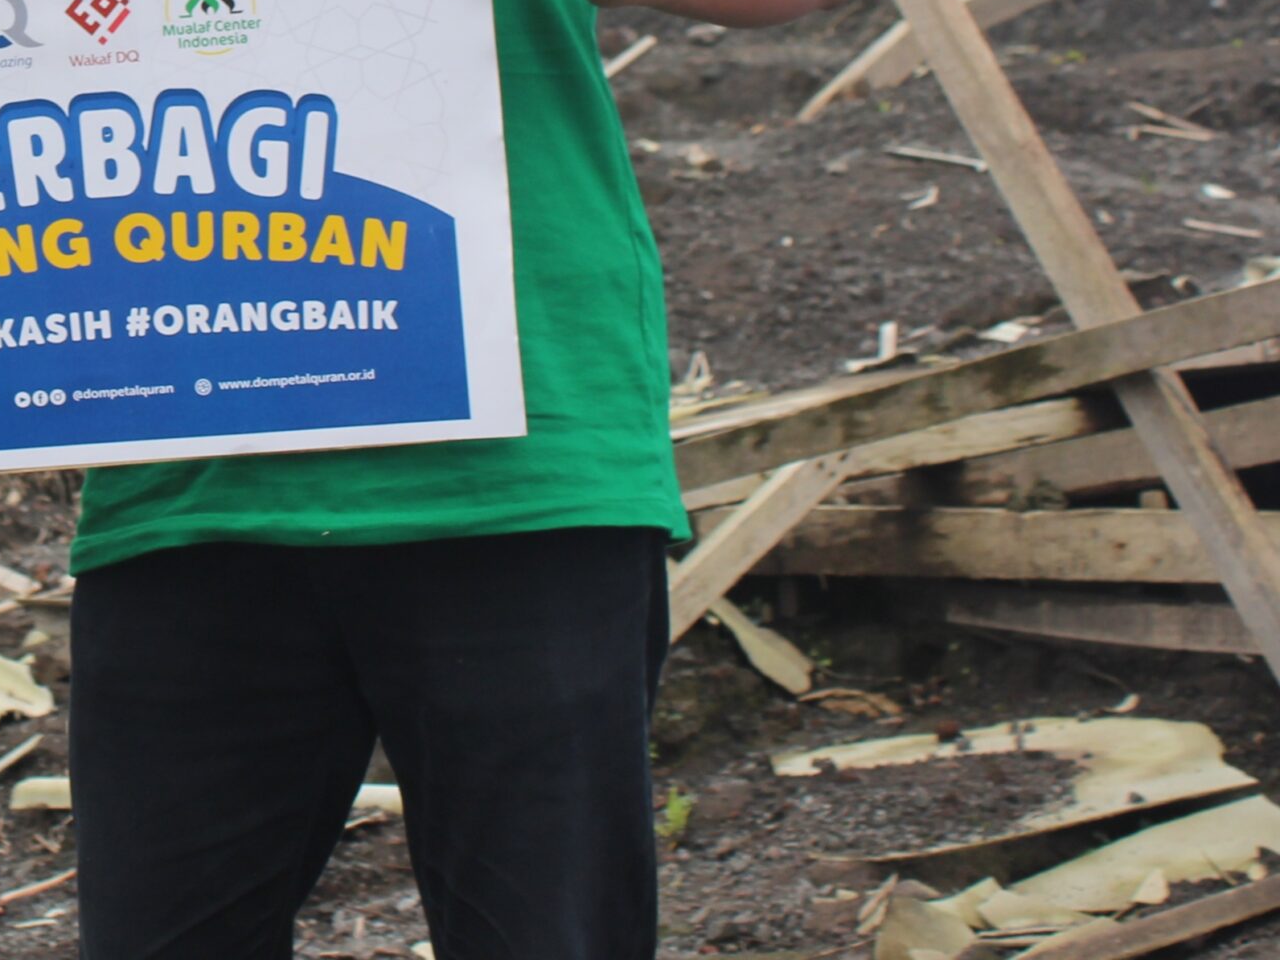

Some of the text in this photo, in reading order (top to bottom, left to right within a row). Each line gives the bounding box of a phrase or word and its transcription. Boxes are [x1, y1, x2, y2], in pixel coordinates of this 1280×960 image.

[163, 17, 262, 38] Mualaf Center
[178, 32, 249, 50] Indonesia
[68, 50, 140, 69] Wakaf DQ
[114, 210, 408, 271] QURBAN
[125, 300, 399, 338] #ORANGBAIK
[72, 384, 174, 402] @dompetalquran
[218, 369, 376, 391] www.dompetalquran.or.id
